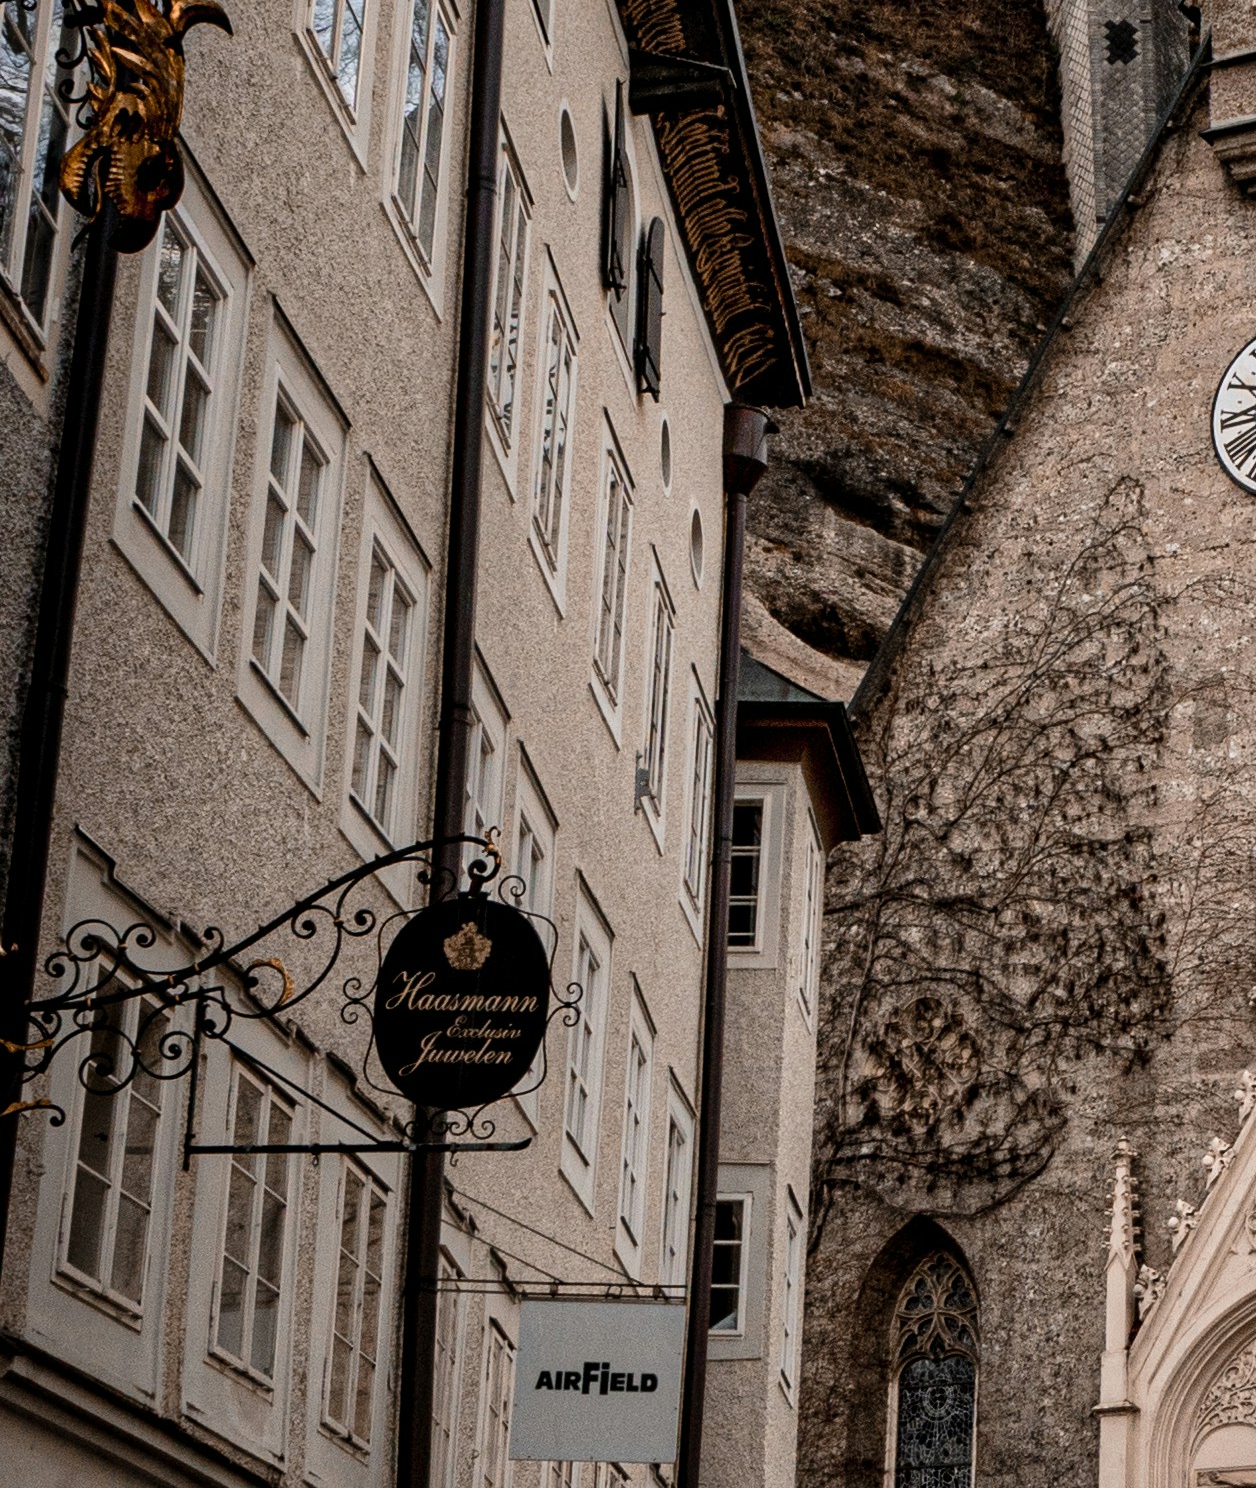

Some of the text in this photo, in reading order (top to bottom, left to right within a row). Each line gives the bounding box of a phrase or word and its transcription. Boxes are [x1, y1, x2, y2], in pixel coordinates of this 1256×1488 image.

[385, 970, 539, 1012] Haasmann
[446, 1015, 522, 1039] Exclusiv
[398, 1030, 514, 1076] Juwelen
